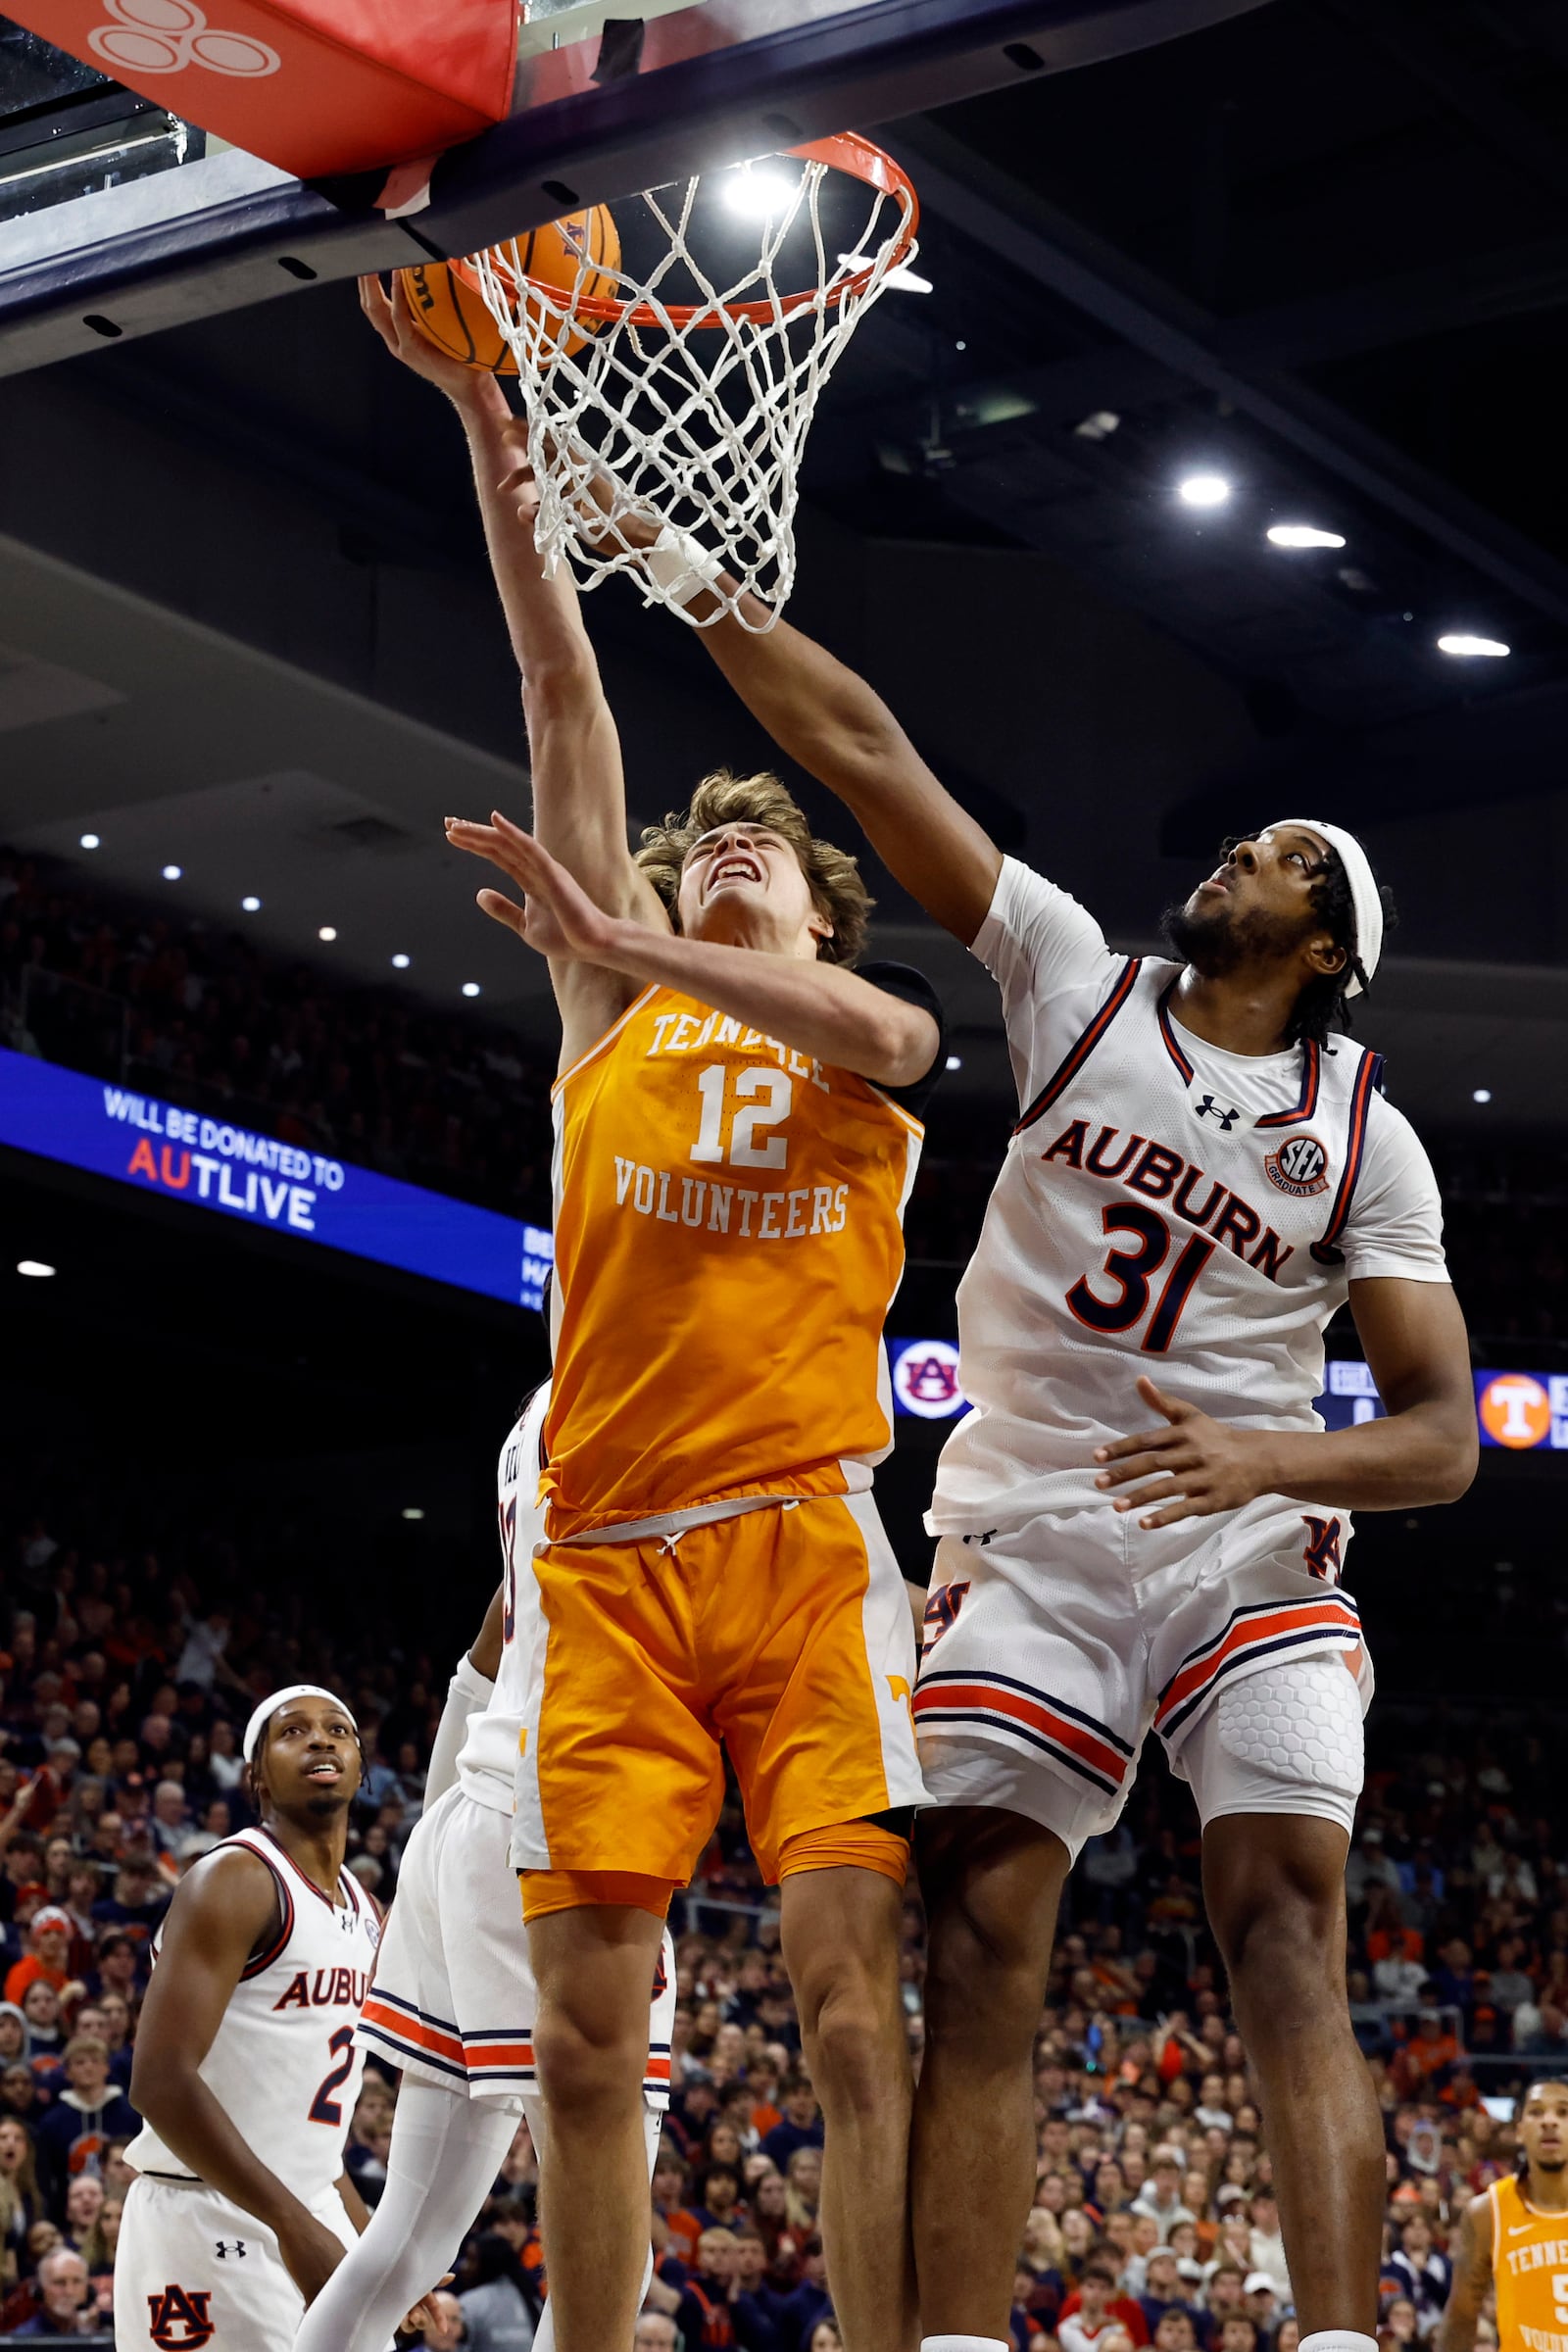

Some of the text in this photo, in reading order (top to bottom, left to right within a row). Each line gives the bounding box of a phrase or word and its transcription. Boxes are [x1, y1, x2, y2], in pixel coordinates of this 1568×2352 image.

[104, 1086, 345, 1192] WILL BE DONATED TO
[689, 1064, 793, 1169] 12
[1281, 1139, 1324, 1182] SEC
[127, 1138, 317, 1232] AUTLIVE
[613, 1155, 850, 1239] VOLUNTEERS
[1041, 1119, 1295, 1283] AUBURN
[1268, 1165, 1316, 1195] GRADUATE
[1065, 1201, 1216, 1353] 31
[308, 2025, 356, 2128] 2
